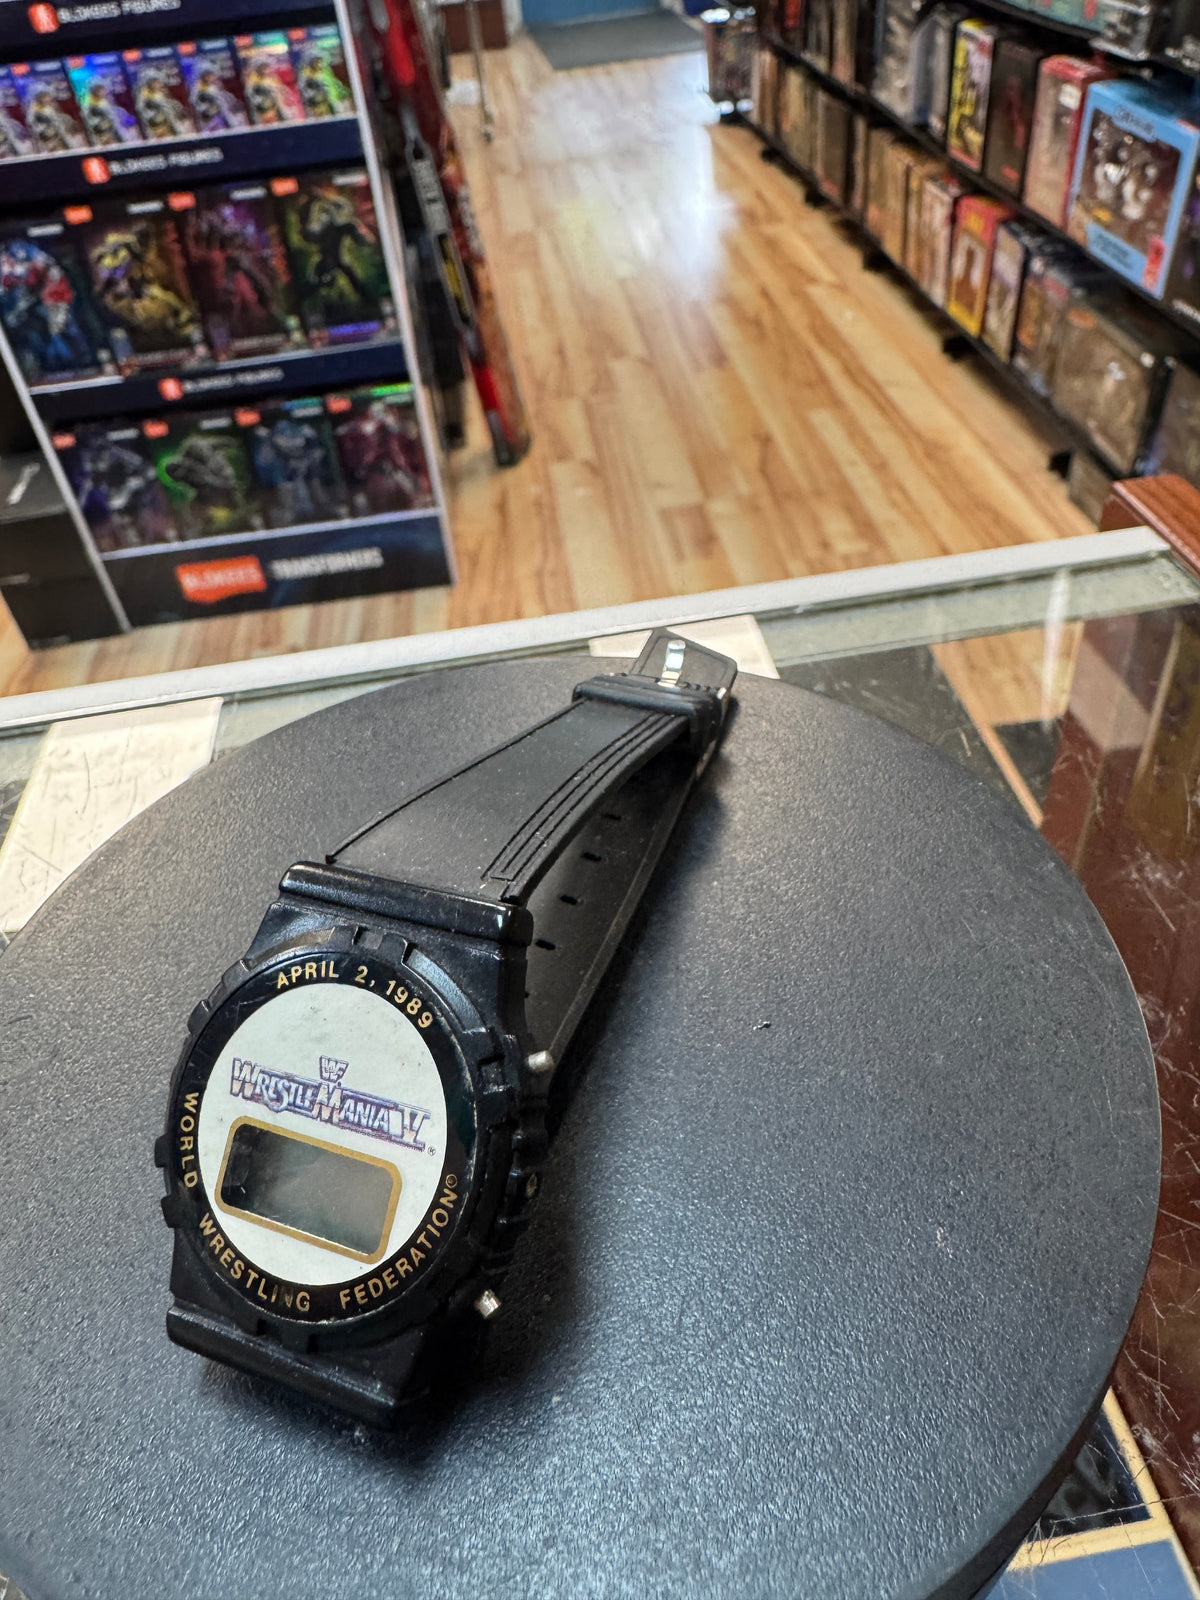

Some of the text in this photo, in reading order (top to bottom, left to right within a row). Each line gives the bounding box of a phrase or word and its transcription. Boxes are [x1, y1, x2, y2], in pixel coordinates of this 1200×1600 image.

[277, 960, 434, 1028] APRIL 2, 1989
[230, 1057, 391, 1134] WRESTLEMANIA
[180, 1092, 199, 1188] WORLD
[199, 1212, 311, 1312] WRESTLING
